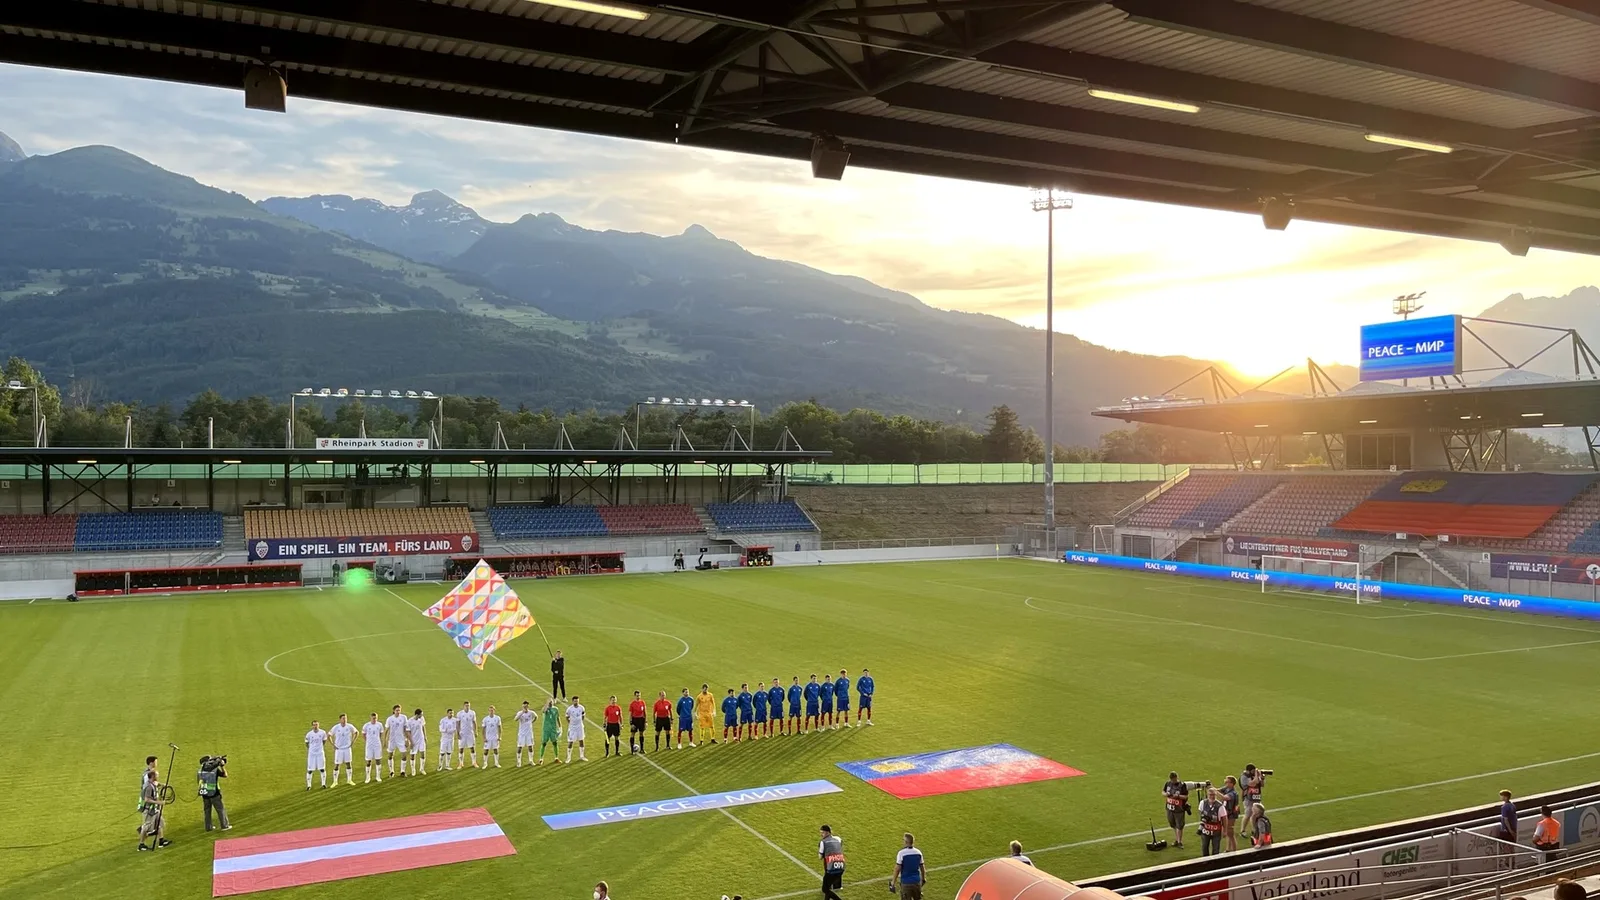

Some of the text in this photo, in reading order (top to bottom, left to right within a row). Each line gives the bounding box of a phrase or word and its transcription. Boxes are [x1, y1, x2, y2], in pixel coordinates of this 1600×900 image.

[1368, 344, 1404, 358] PEACE
[1415, 340, 1444, 353] МИР
[332, 439, 414, 448] Rheinpark Stadion
[278, 539, 453, 556] EIN SPIEL. EIN TEAM. FÜRS LAND.
[1071, 554, 1085, 562] PEACE
[1144, 562, 1160, 570] PEACE
[1164, 564, 1178, 572] МИР
[1231, 570, 1249, 580] PEACE
[1334, 581, 1357, 591] PEACE
[1363, 584, 1381, 593] МИР
[1463, 594, 1491, 606] PEACE
[1498, 597, 1521, 608] МИР
[597, 800, 698, 821] PEACE
[724, 787, 791, 804] МИР
[1381, 844, 1420, 866] CHESI
[1246, 858, 1361, 900] Vaterland
